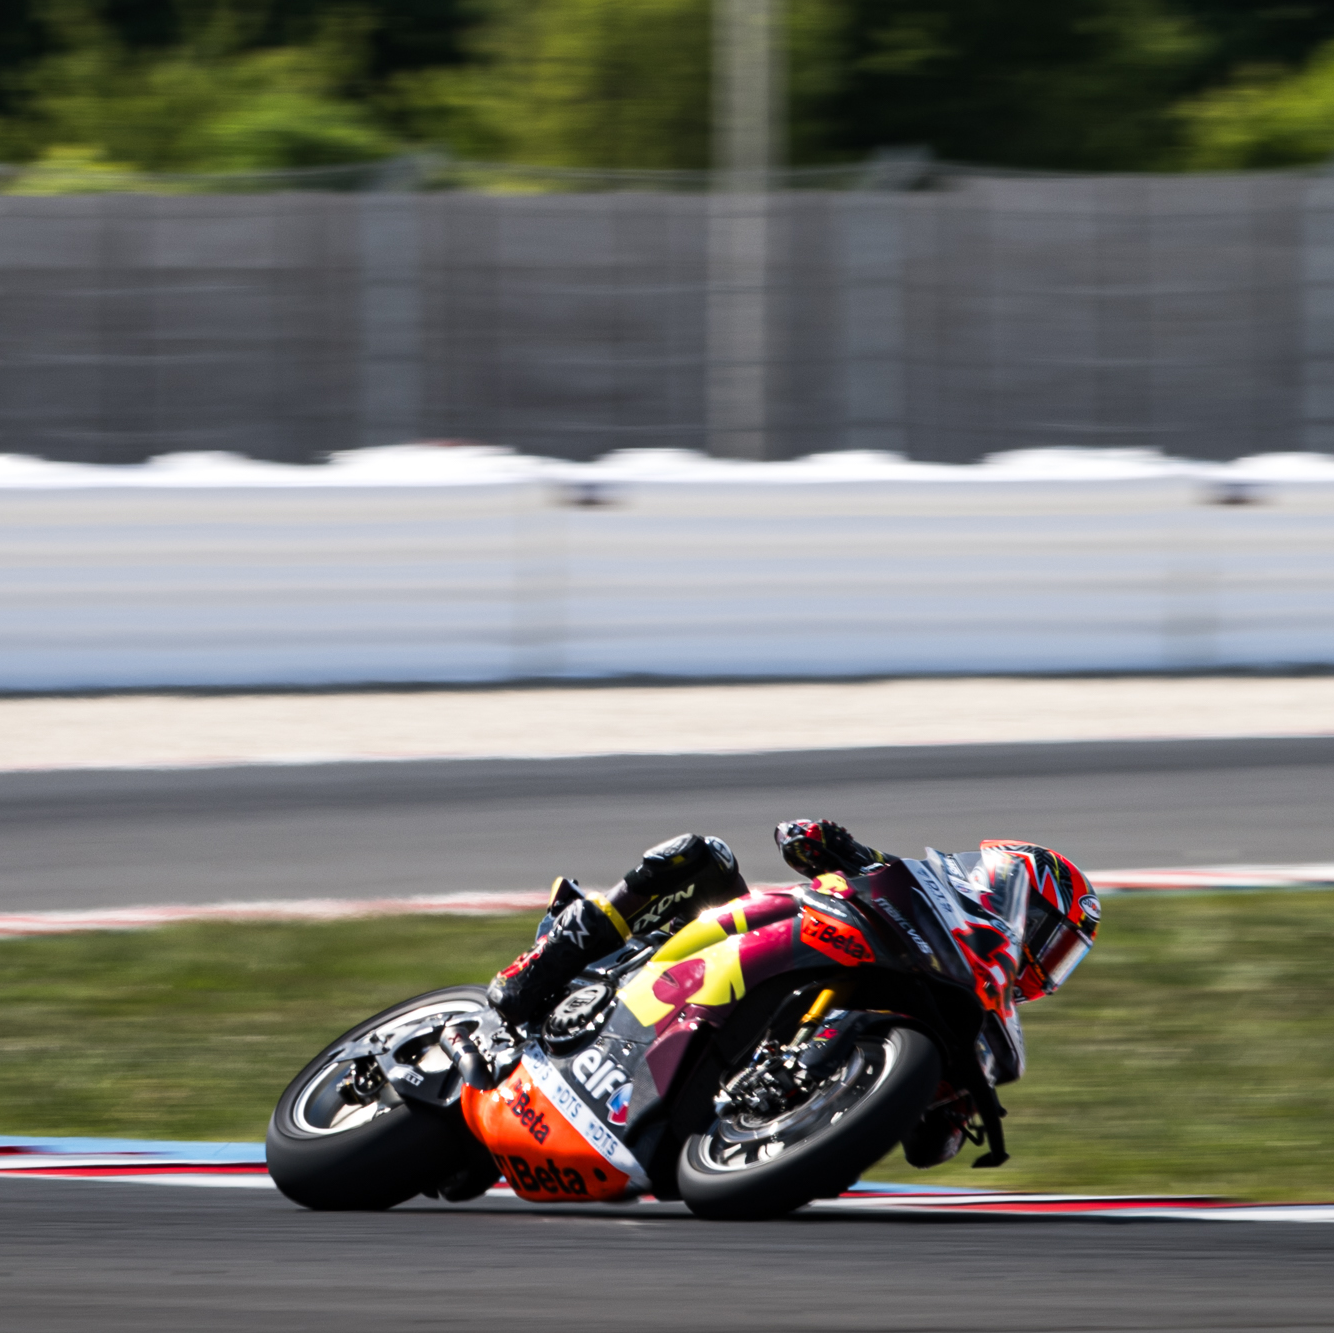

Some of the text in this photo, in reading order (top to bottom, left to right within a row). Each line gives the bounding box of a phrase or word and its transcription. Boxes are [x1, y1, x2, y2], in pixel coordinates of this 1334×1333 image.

[818, 925, 866, 960] Beta
[572, 1049, 626, 1100] elf
[512, 1091, 551, 1145] Beta
[558, 1087, 583, 1119] DTS
[592, 1124, 619, 1156] DTS
[511, 1155, 588, 1196] Beta
